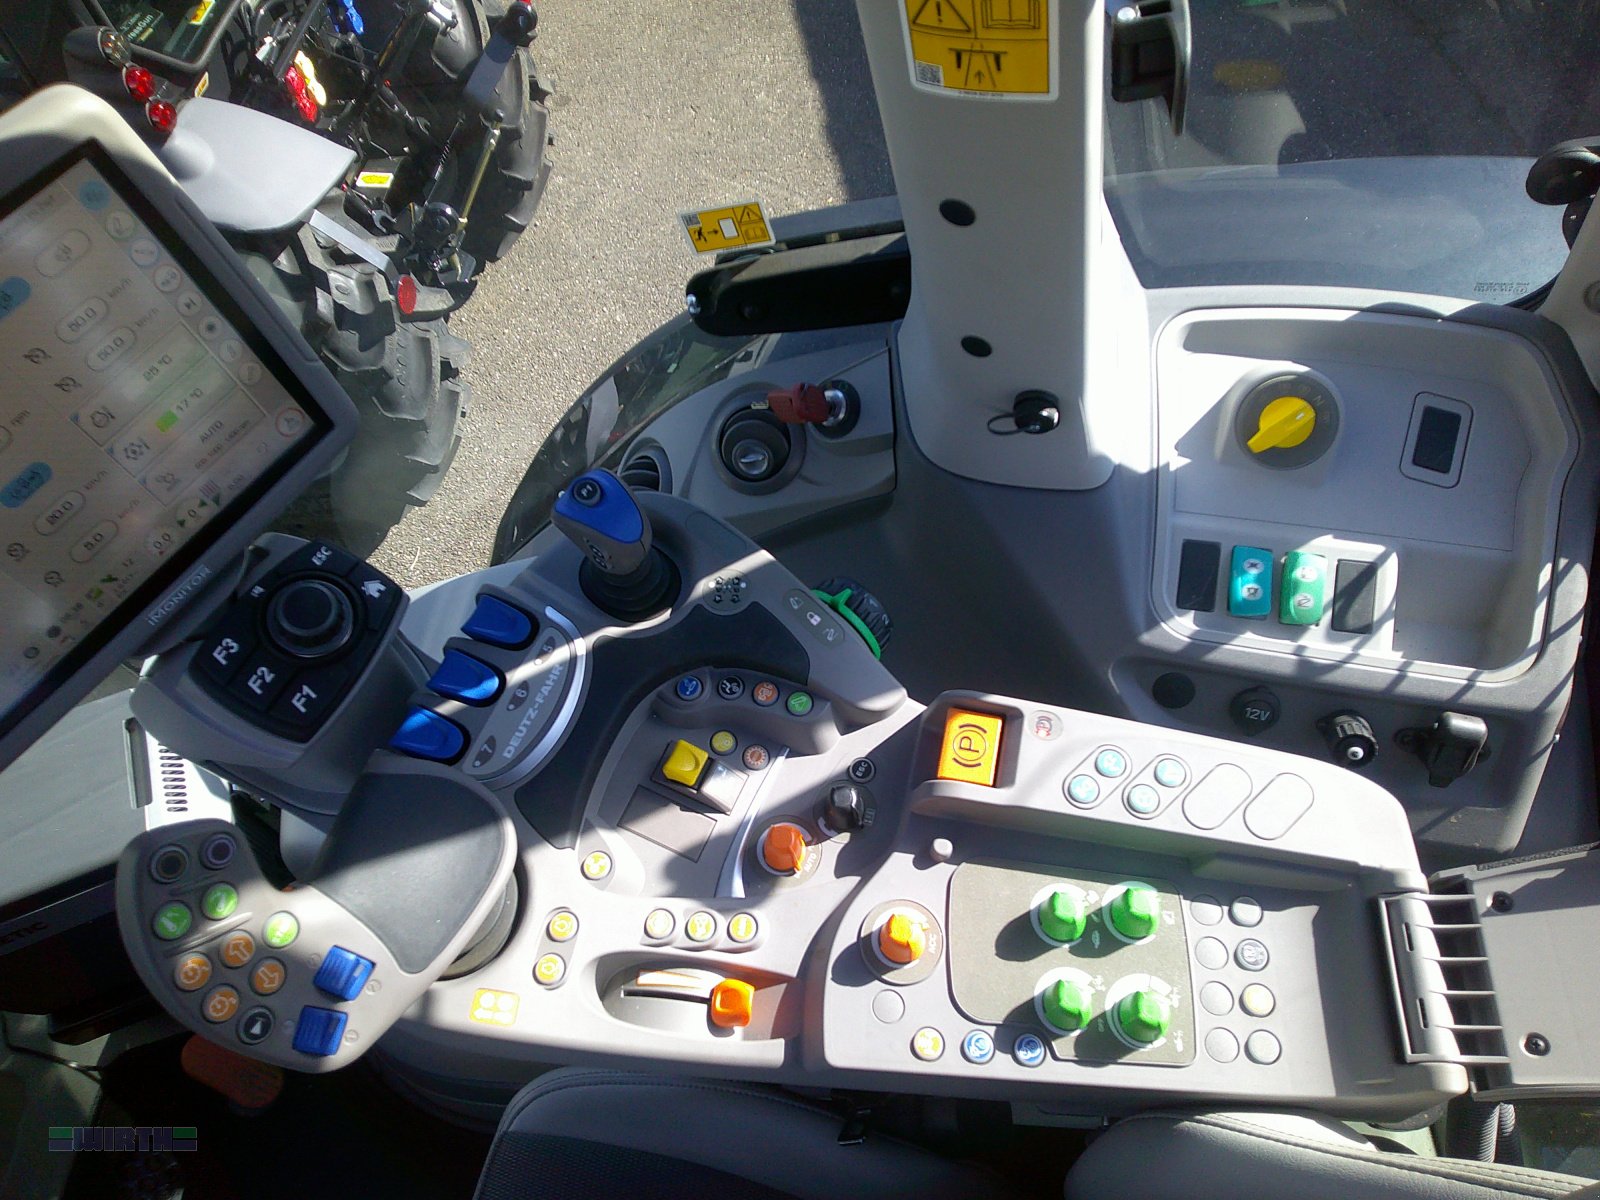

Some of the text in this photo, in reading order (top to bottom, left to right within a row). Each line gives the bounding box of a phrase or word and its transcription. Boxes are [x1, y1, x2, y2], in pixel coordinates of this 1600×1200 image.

[311, 546, 333, 567] ESC
[147, 565, 213, 627] iMONITOR
[212, 637, 241, 666] F3
[247, 666, 275, 695] F2
[291, 684, 318, 713] F1
[502, 663, 564, 759] DEUTZ-FAHR
[1245, 706, 1271, 721] 12V
[481, 743, 493, 755] 7
[928, 933, 938, 955] ACC
